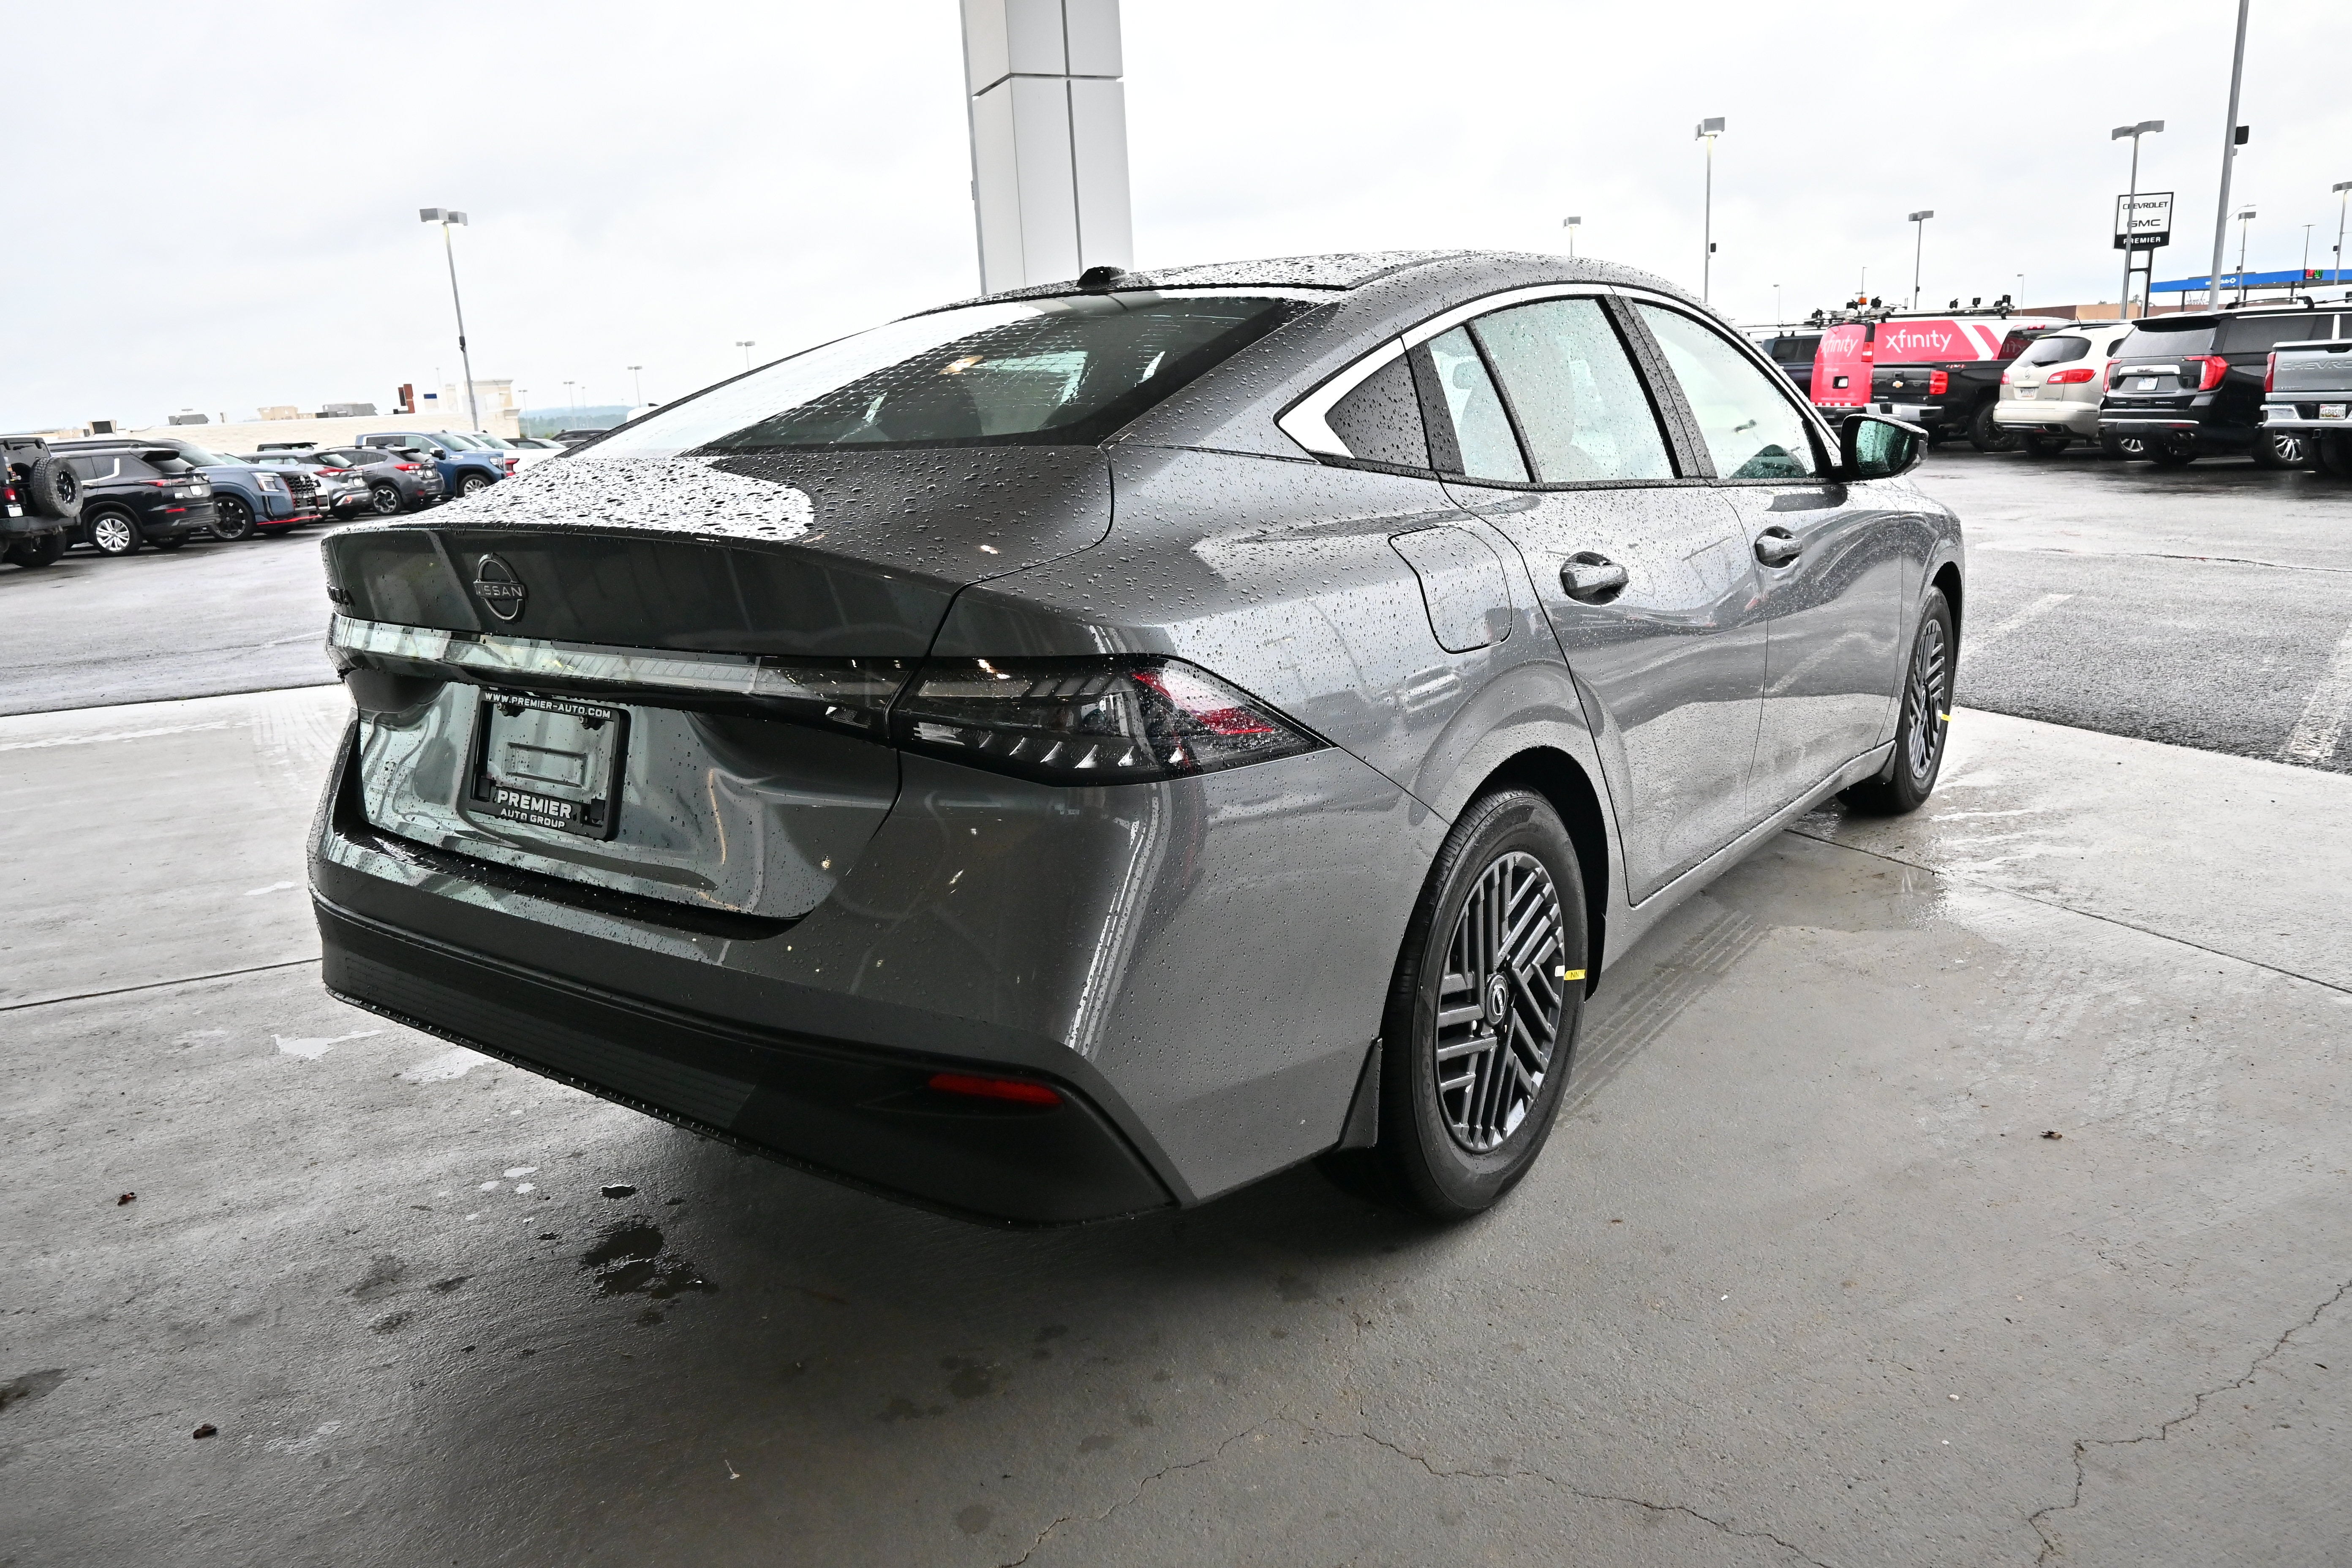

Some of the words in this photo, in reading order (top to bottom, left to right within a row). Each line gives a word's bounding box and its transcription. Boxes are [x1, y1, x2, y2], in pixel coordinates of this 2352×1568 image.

[1821, 334, 1859, 358] xfinity
[1886, 329, 1952, 353] xfinity
[485, 692, 611, 719] WWW.PREMIER-AUTO.COM
[497, 790, 572, 819] PREMIER
[501, 808, 527, 821] AUTO
[530, 814, 565, 828] GROUP
